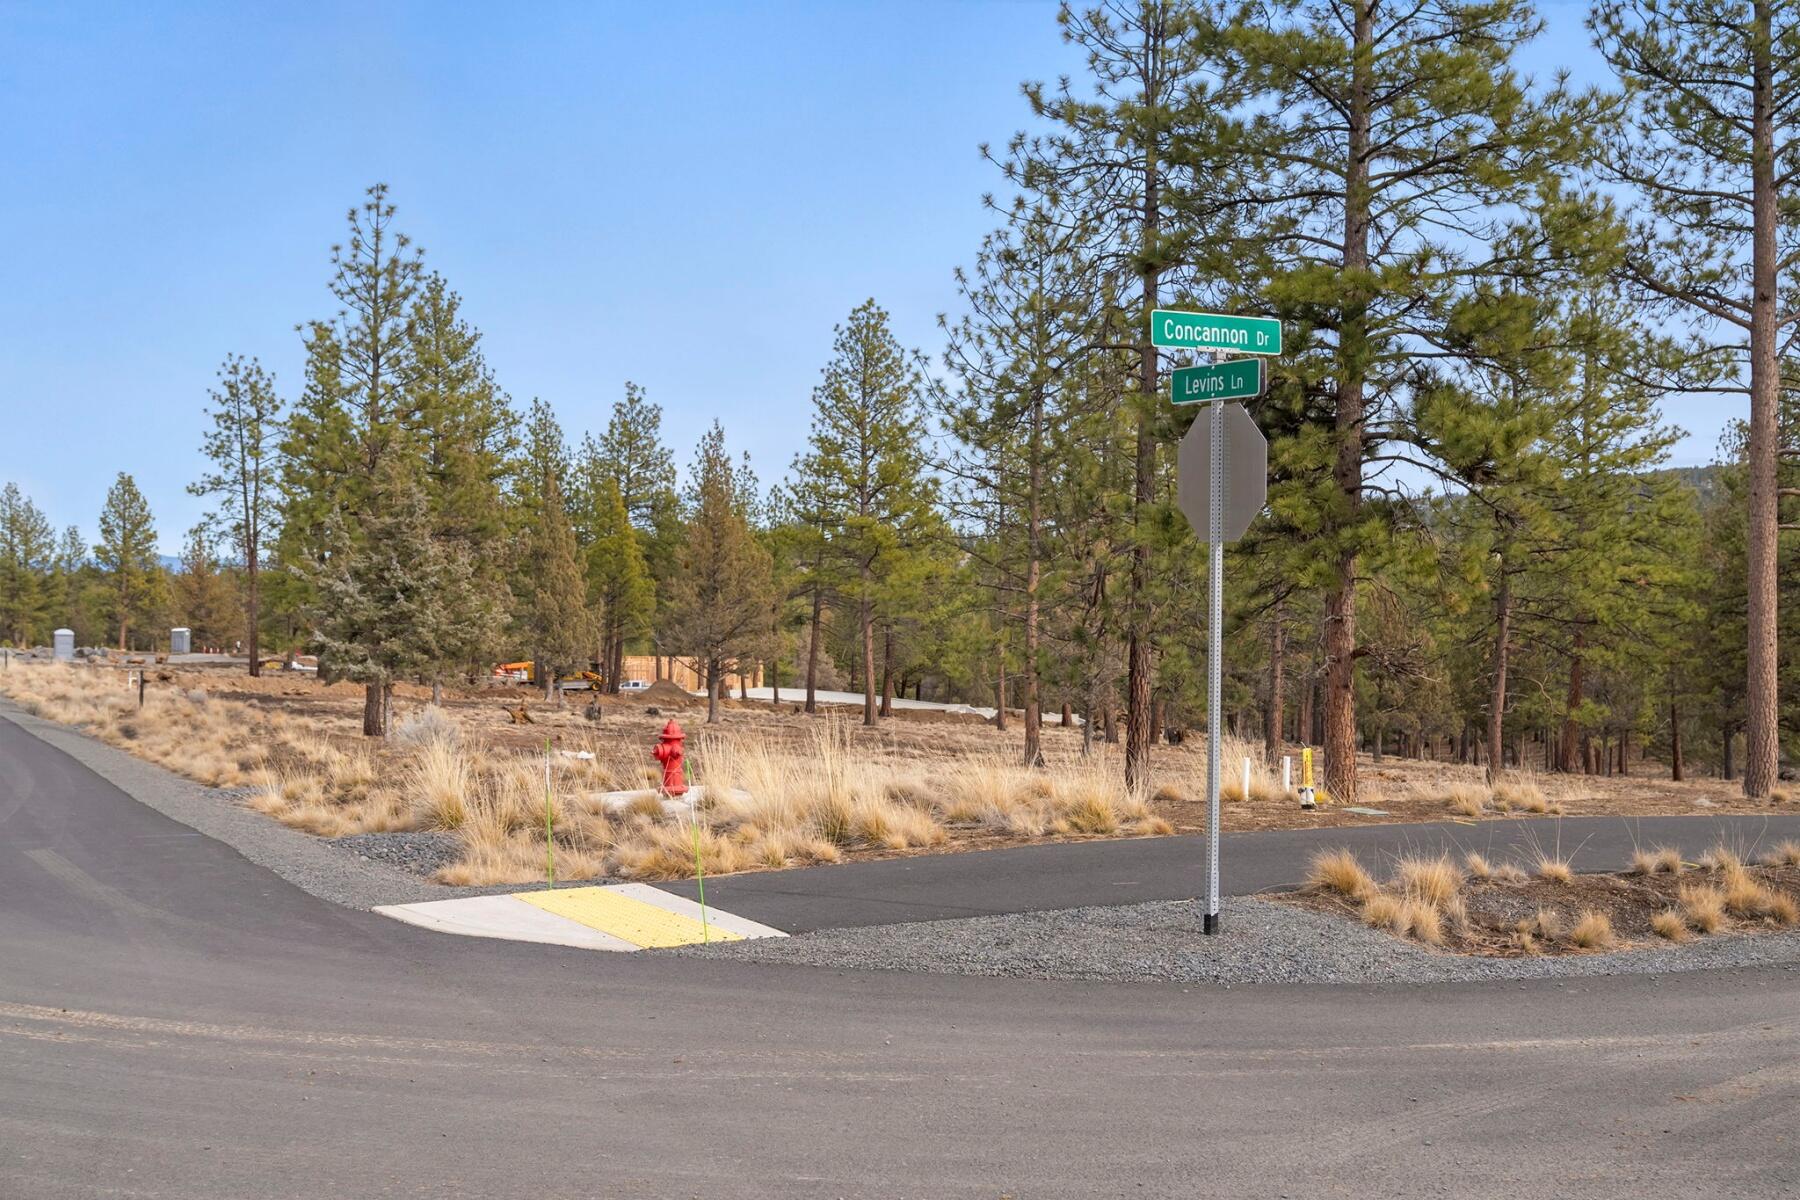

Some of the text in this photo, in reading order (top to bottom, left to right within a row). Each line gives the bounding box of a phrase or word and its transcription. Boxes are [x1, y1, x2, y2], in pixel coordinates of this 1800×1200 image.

[1164, 319, 1269, 346] Concannon Dr
[1185, 373, 1243, 394] Levins Ln
